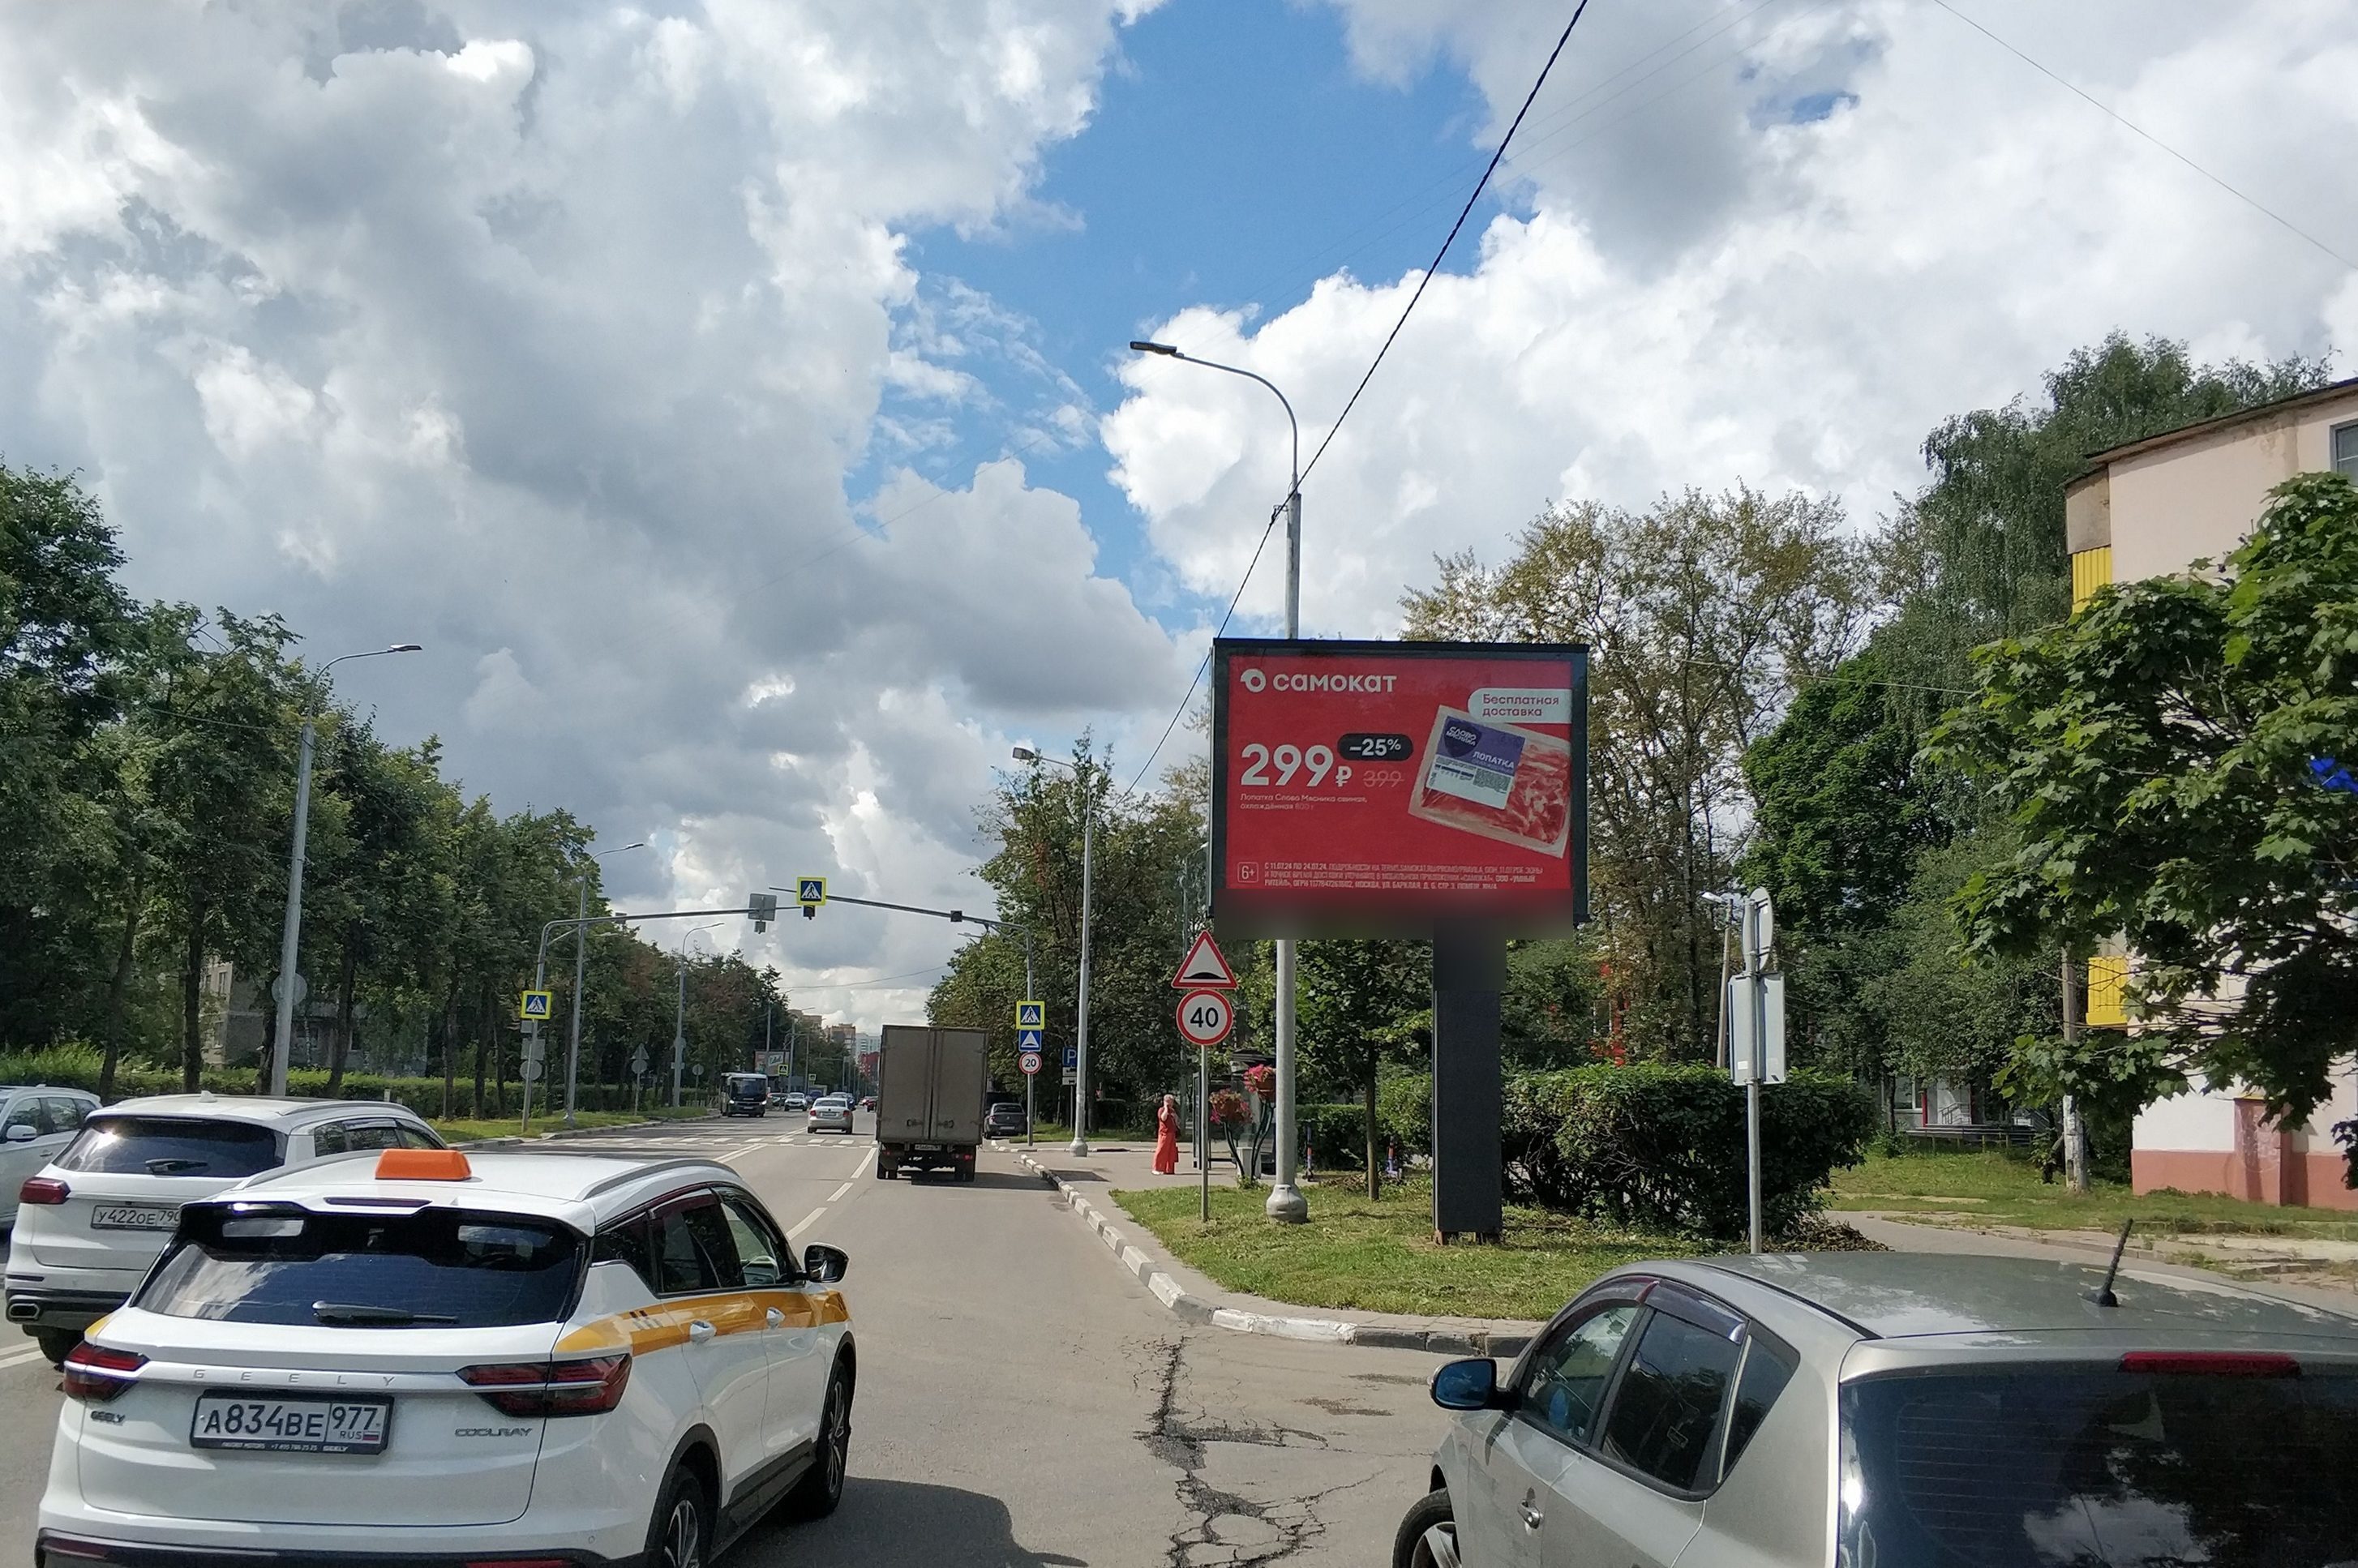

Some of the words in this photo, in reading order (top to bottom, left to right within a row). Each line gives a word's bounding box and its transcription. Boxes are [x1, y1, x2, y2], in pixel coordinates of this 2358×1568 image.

[1273, 674, 1397, 692] самокат
[1482, 693, 1558, 705] Бесплатная
[1482, 708, 1542, 718] доставка
[1473, 752, 1515, 769] ЛОПАТКА
[1363, 770, 1404, 788] 399
[1240, 793, 1274, 801] Лопатка
[1275, 794, 1300, 802] Слово
[1301, 795, 1335, 803] Мясника
[1241, 866, 1255, 880] 6+
[1190, 1007, 1219, 1028] 40
[1025, 1059, 1037, 1067] 20
[1067, 1049, 1077, 1064] P
[98, 1209, 156, 1225] У422ОЕ
[194, 1369, 396, 1386] GEELY
[204, 1403, 324, 1437] А834ВЕ
[332, 1406, 378, 1430] 977
[339, 1430, 362, 1440] RUS
[455, 1427, 533, 1437] COOLRAY
